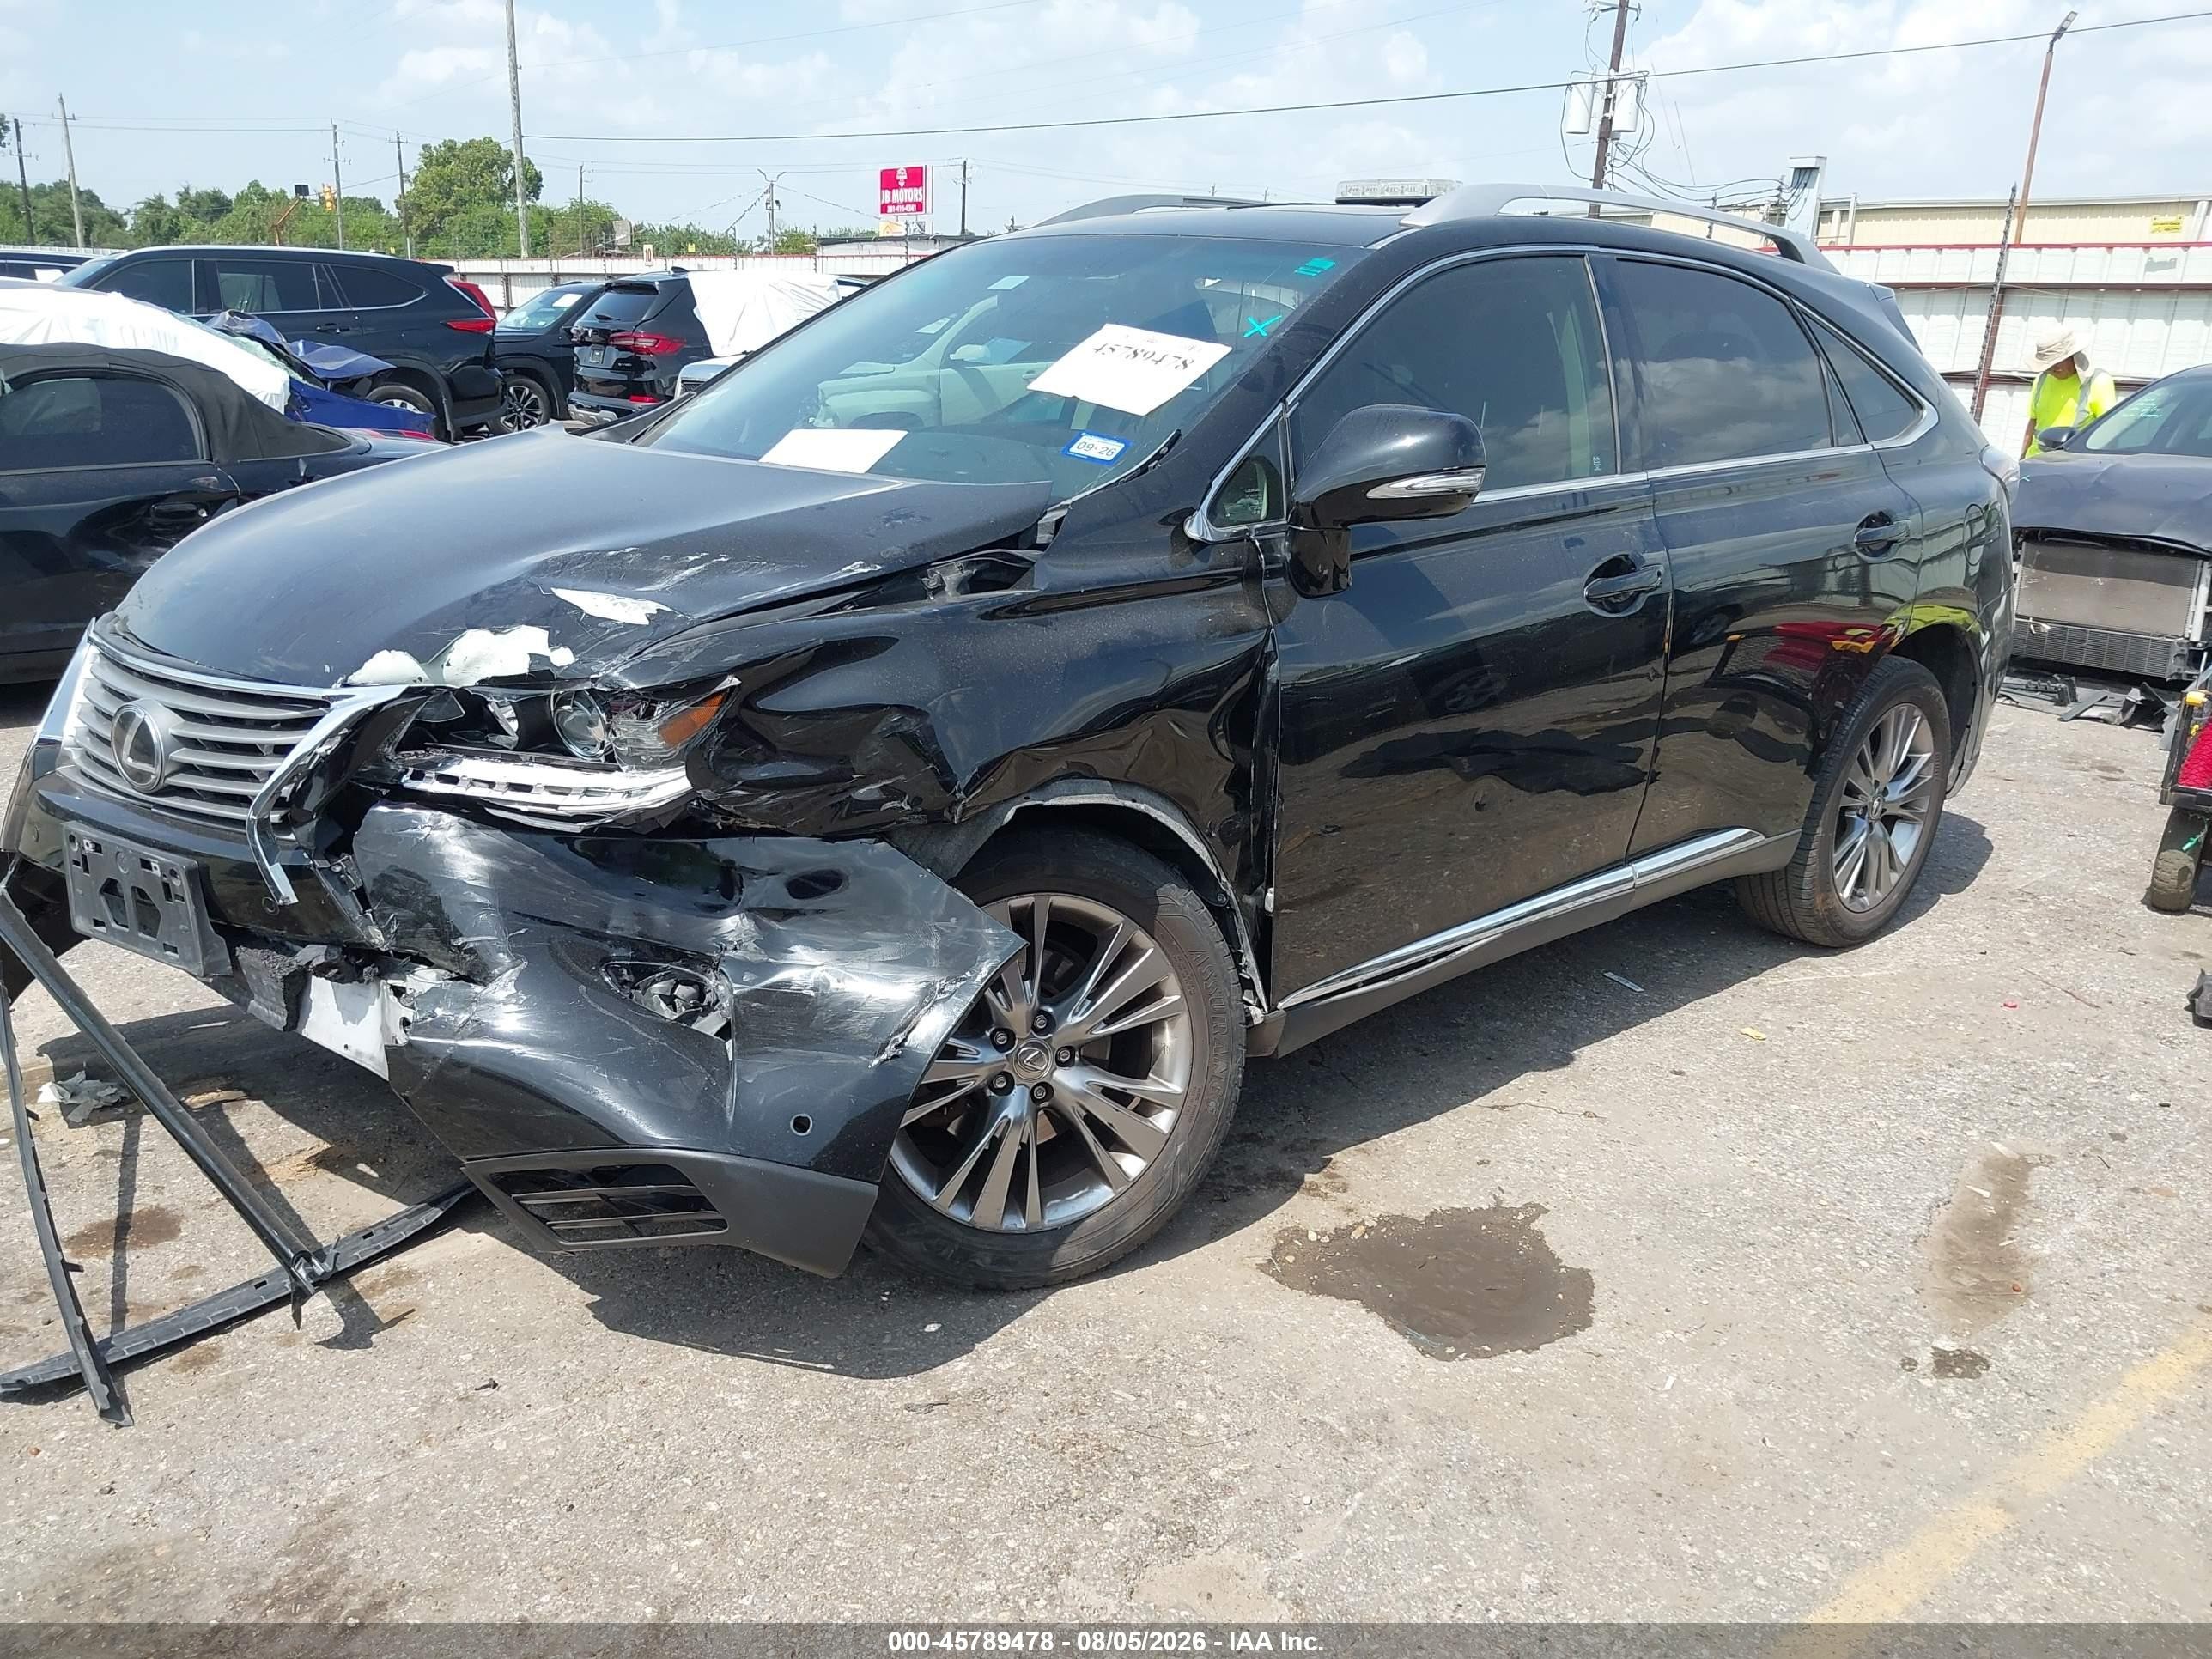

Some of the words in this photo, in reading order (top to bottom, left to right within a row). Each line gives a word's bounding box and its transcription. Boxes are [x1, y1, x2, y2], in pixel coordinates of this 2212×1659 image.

[881, 190, 890, 204] JB
[892, 187, 923, 204] MOTORS
[1077, 441, 1095, 452] 09
[1097, 447, 1116, 457] 26
